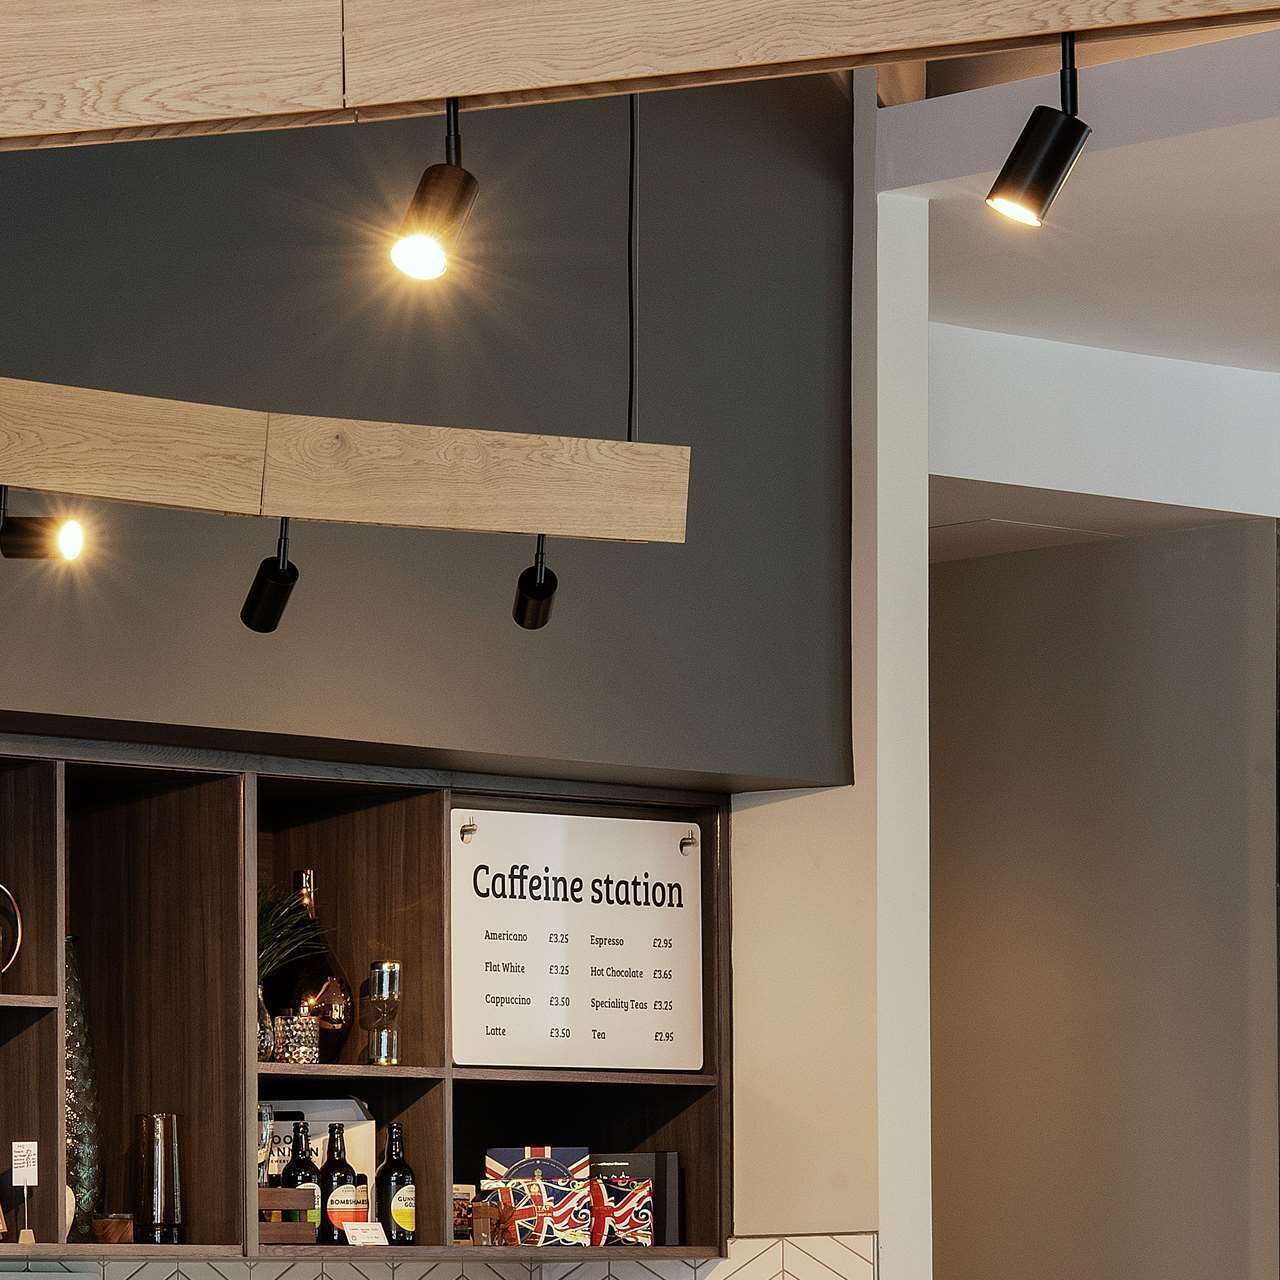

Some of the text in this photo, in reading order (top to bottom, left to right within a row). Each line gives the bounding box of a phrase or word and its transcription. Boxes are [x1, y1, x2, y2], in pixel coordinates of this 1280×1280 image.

[473, 864, 684, 908] Caffeine station
[484, 930, 569, 944] Americano £3.25
[590, 935, 673, 948] Espresso £2.95
[484, 962, 570, 976] Flat White £3.25
[590, 967, 605, 978] Hot
[605, 967, 643, 979] Chocolate
[485, 994, 570, 1007] Cappuccino £3.50
[590, 998, 673, 1011] Speciality Teas £3.25
[485, 1026, 571, 1039] Latte £3.50
[592, 1029, 674, 1042] Tea £2.95
